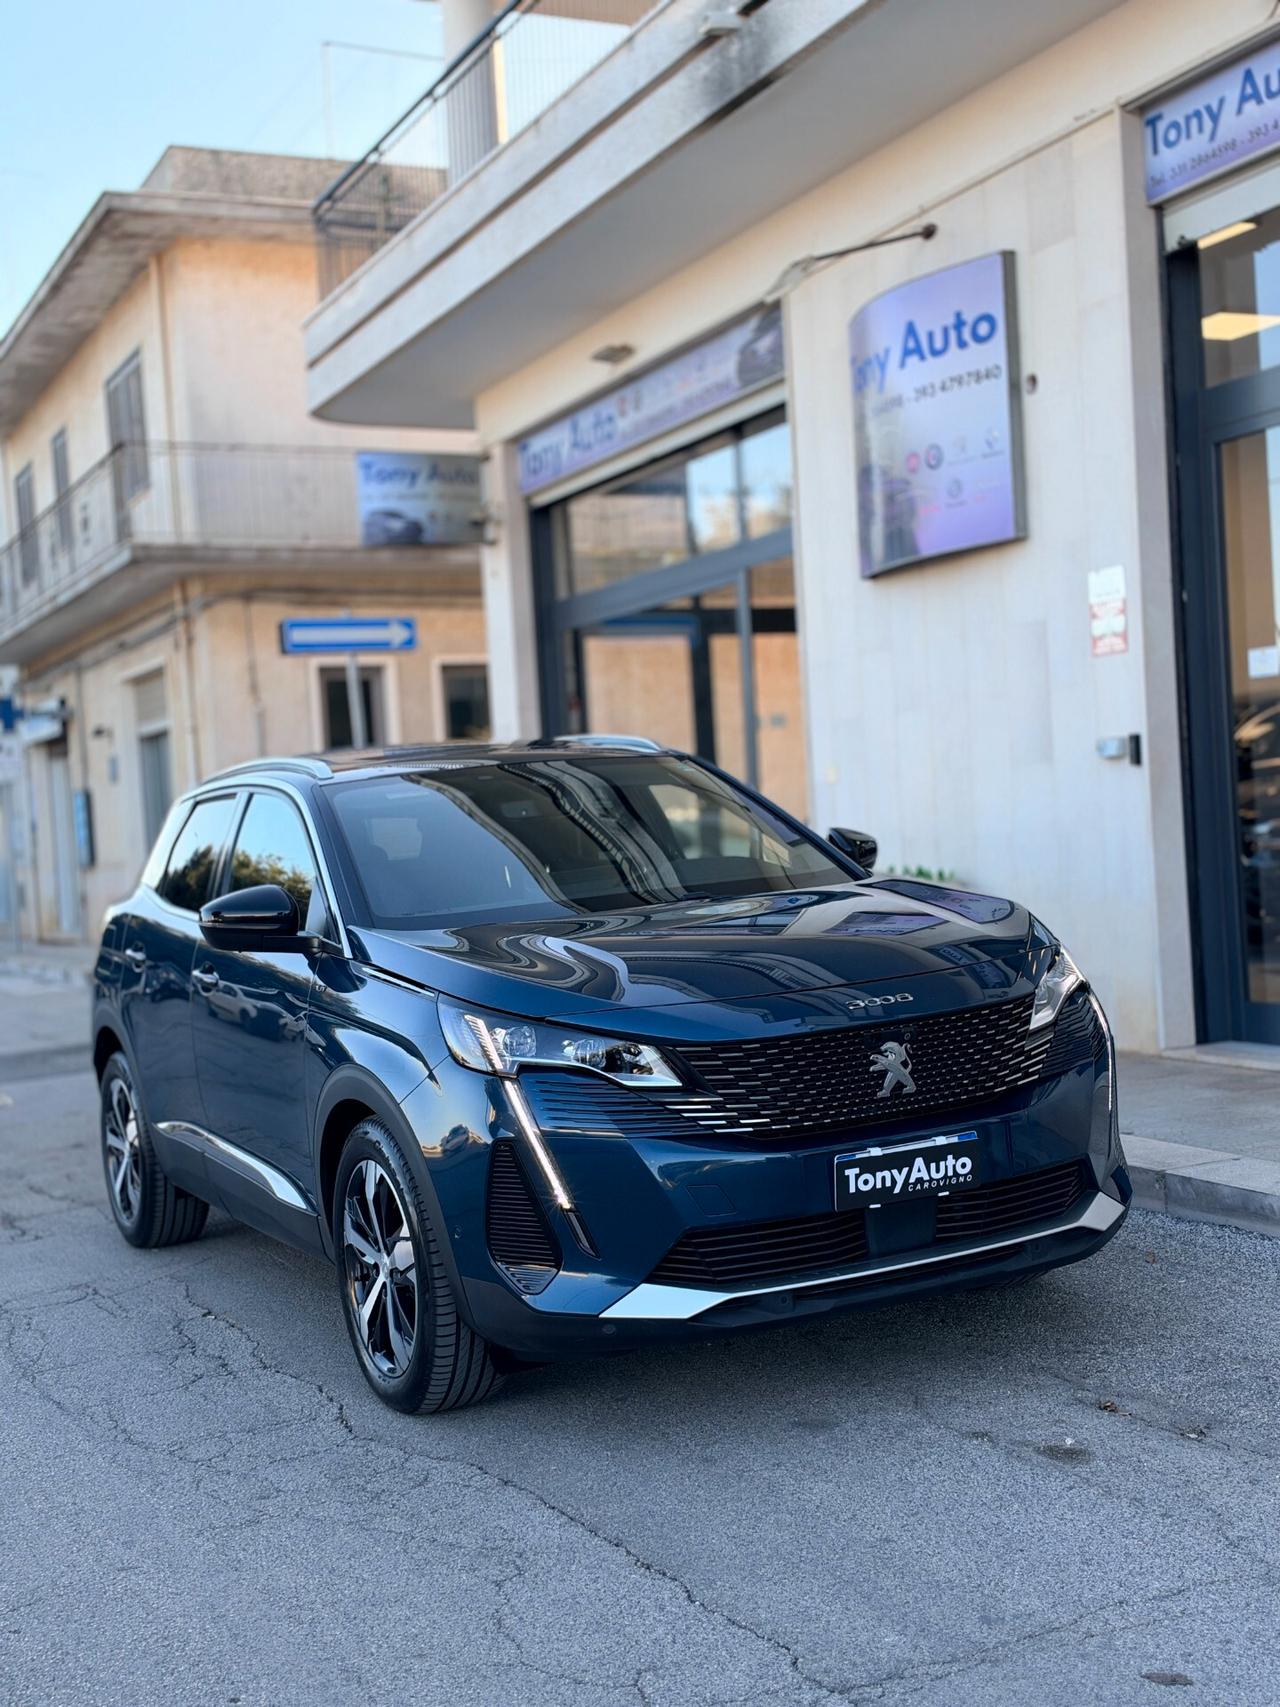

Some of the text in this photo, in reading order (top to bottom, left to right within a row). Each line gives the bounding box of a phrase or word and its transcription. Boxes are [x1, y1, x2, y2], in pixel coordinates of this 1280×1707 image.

[1145, 67, 1280, 156] Tony Au
[899, 310, 997, 370] Auto
[359, 459, 420, 490] Tony
[908, 1174, 973, 1192] CAROVIGNO
